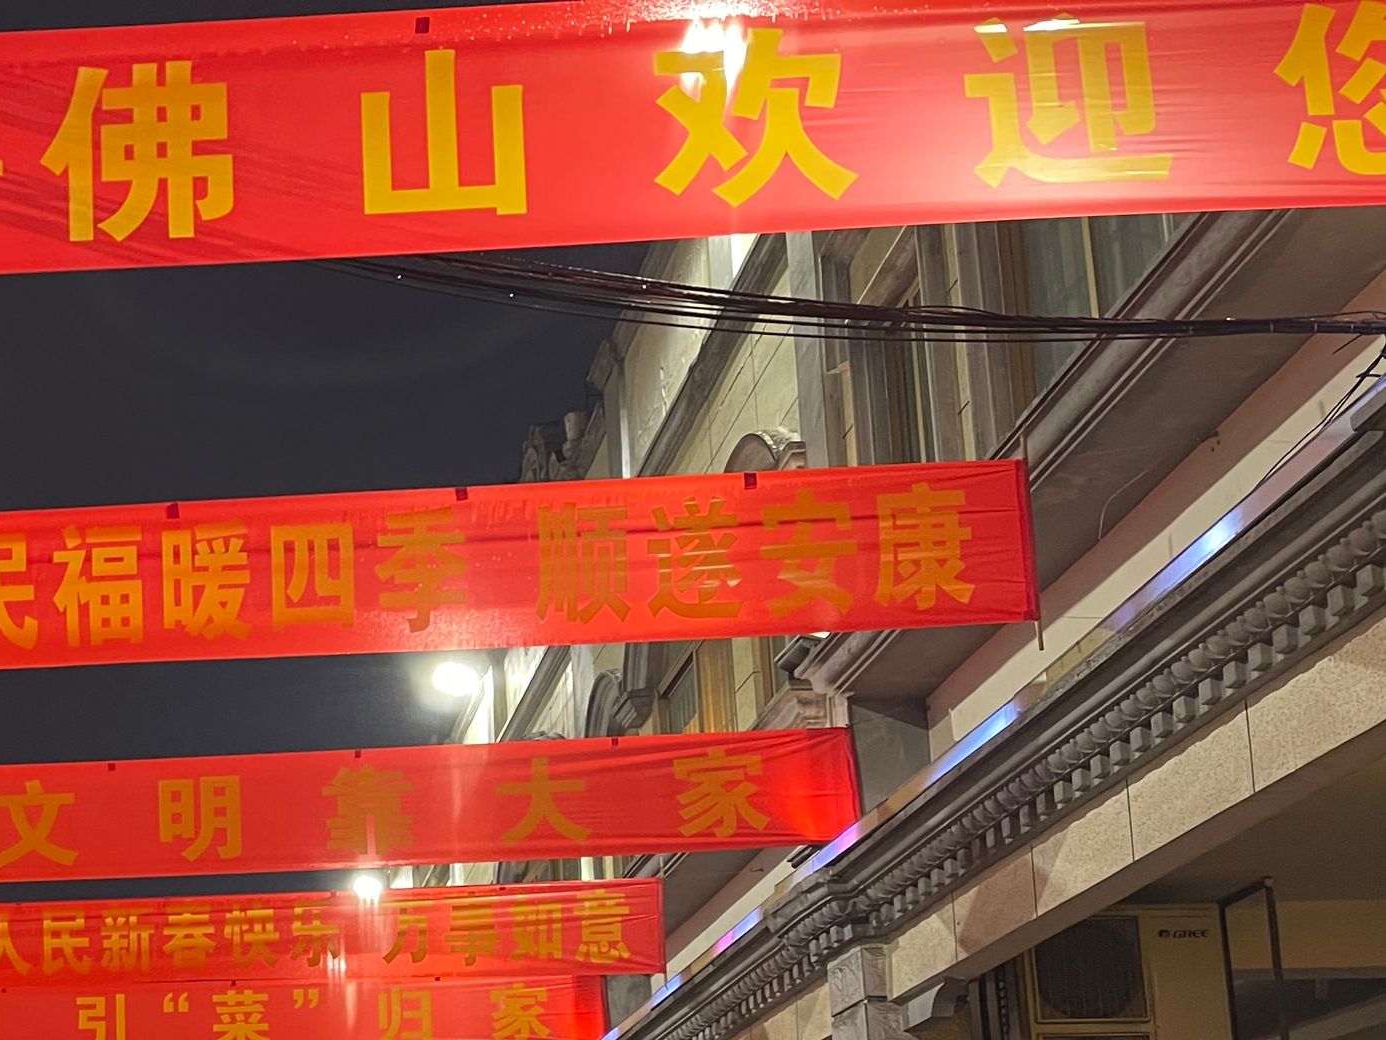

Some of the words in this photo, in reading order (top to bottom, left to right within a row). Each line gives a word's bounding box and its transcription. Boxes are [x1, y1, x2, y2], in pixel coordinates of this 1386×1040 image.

[534, 482, 975, 624] 顺遂安康
[382, 889, 631, 967] 万事如意
